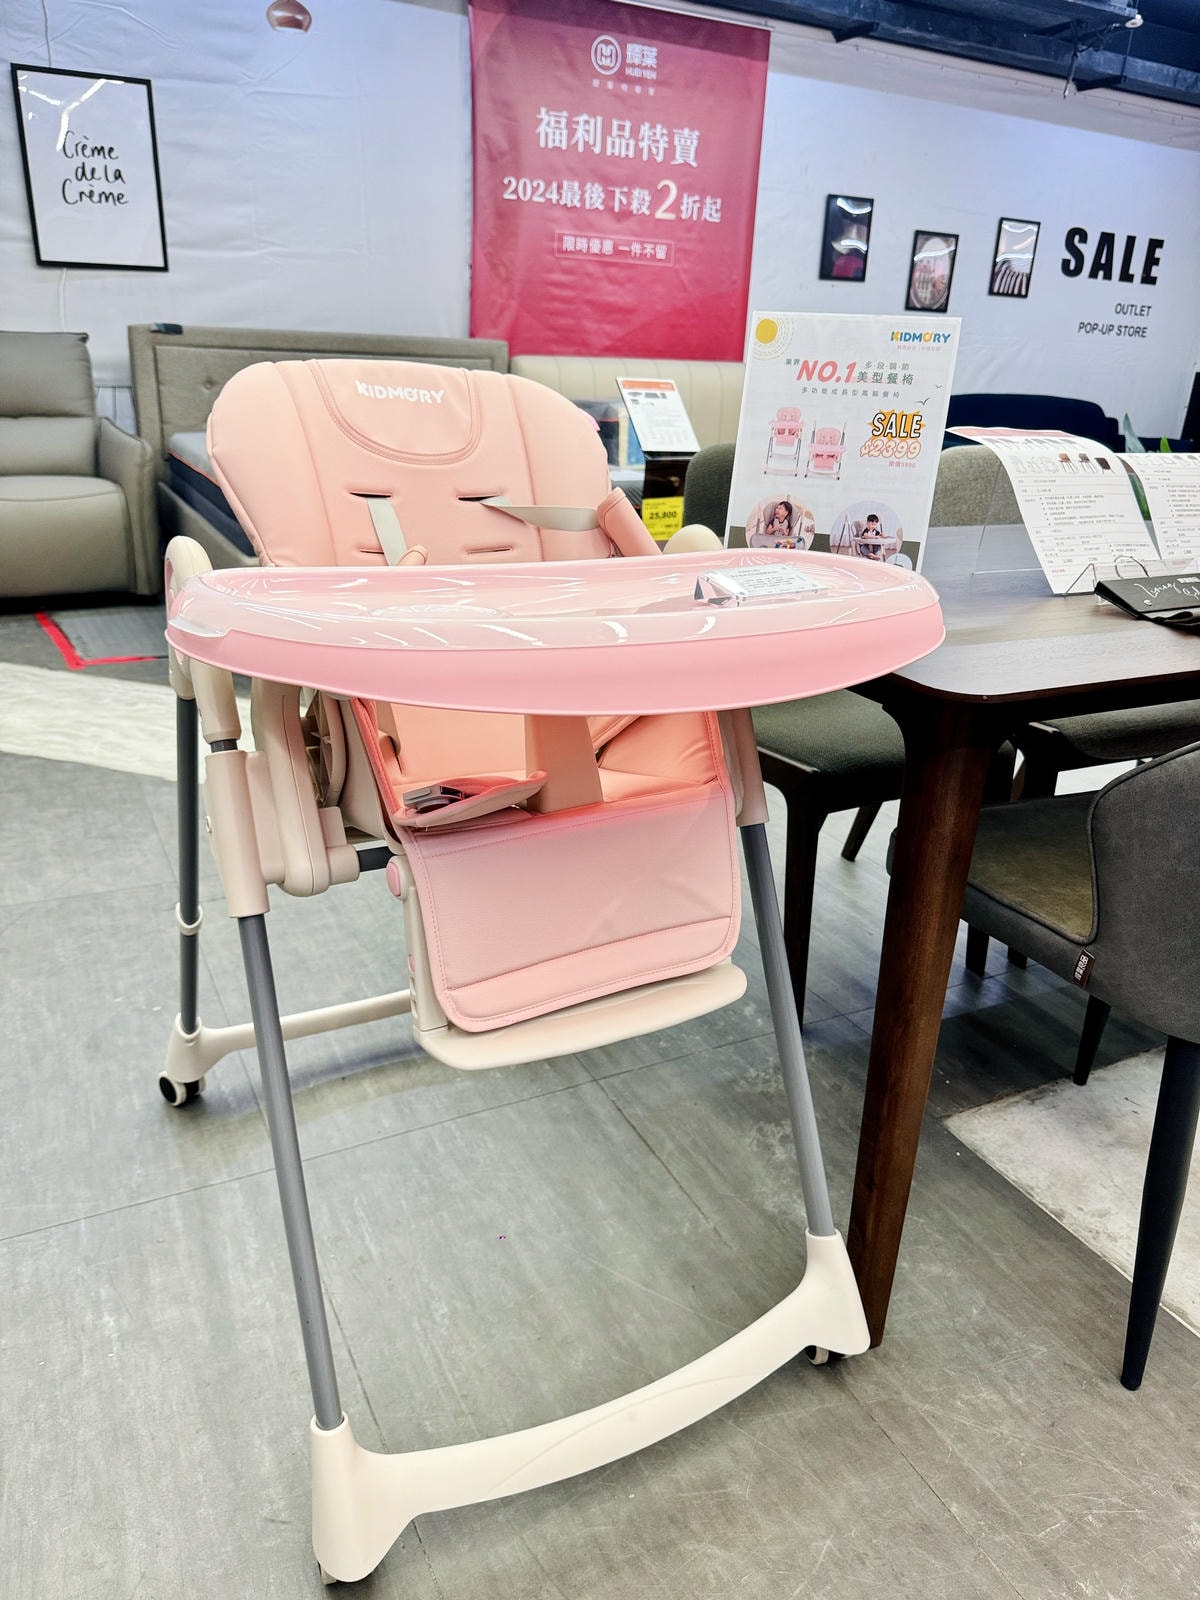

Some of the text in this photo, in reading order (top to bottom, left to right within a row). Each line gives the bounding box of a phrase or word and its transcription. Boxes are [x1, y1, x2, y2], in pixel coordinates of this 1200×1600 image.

[63, 130, 119, 160] Crème
[536, 106, 701, 168] 福利品特賣
[75, 162, 126, 184] de la
[62, 178, 128, 205] Crème
[1061, 226, 1165, 286] SALE
[1114, 303, 1152, 317] OUTLET
[890, 330, 951, 344] KIDMORY
[1077, 321, 1148, 339] POP-UP STORE
[796, 359, 857, 383] NO.1
[856, 371, 914, 386] 美型餐椅
[355, 379, 445, 405] KIDMORY
[871, 411, 923, 439] SALE
[859, 438, 922, 460] $2399
